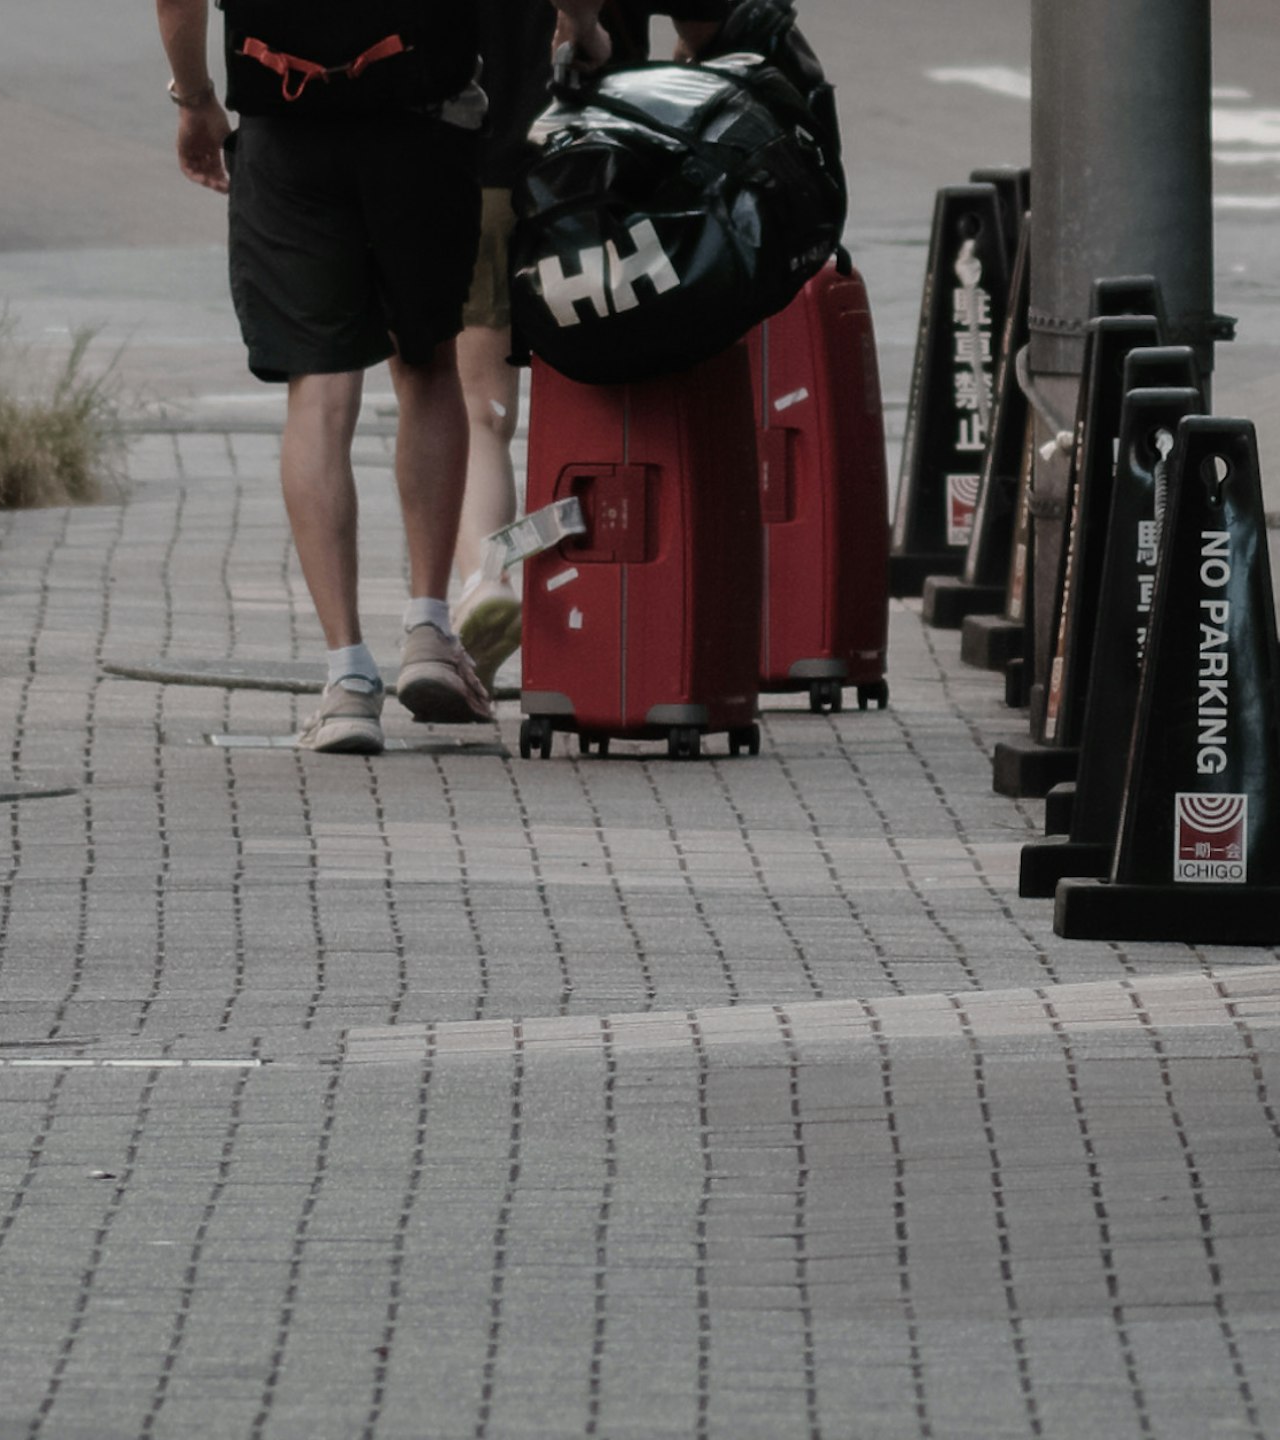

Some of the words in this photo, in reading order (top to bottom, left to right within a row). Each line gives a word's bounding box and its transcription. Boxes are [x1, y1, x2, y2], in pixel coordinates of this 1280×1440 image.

[538, 218, 680, 327] HH
[1199, 530, 1231, 589] NO
[1196, 599, 1230, 775] PARKING
[1178, 862, 1244, 879] ICHIGO
